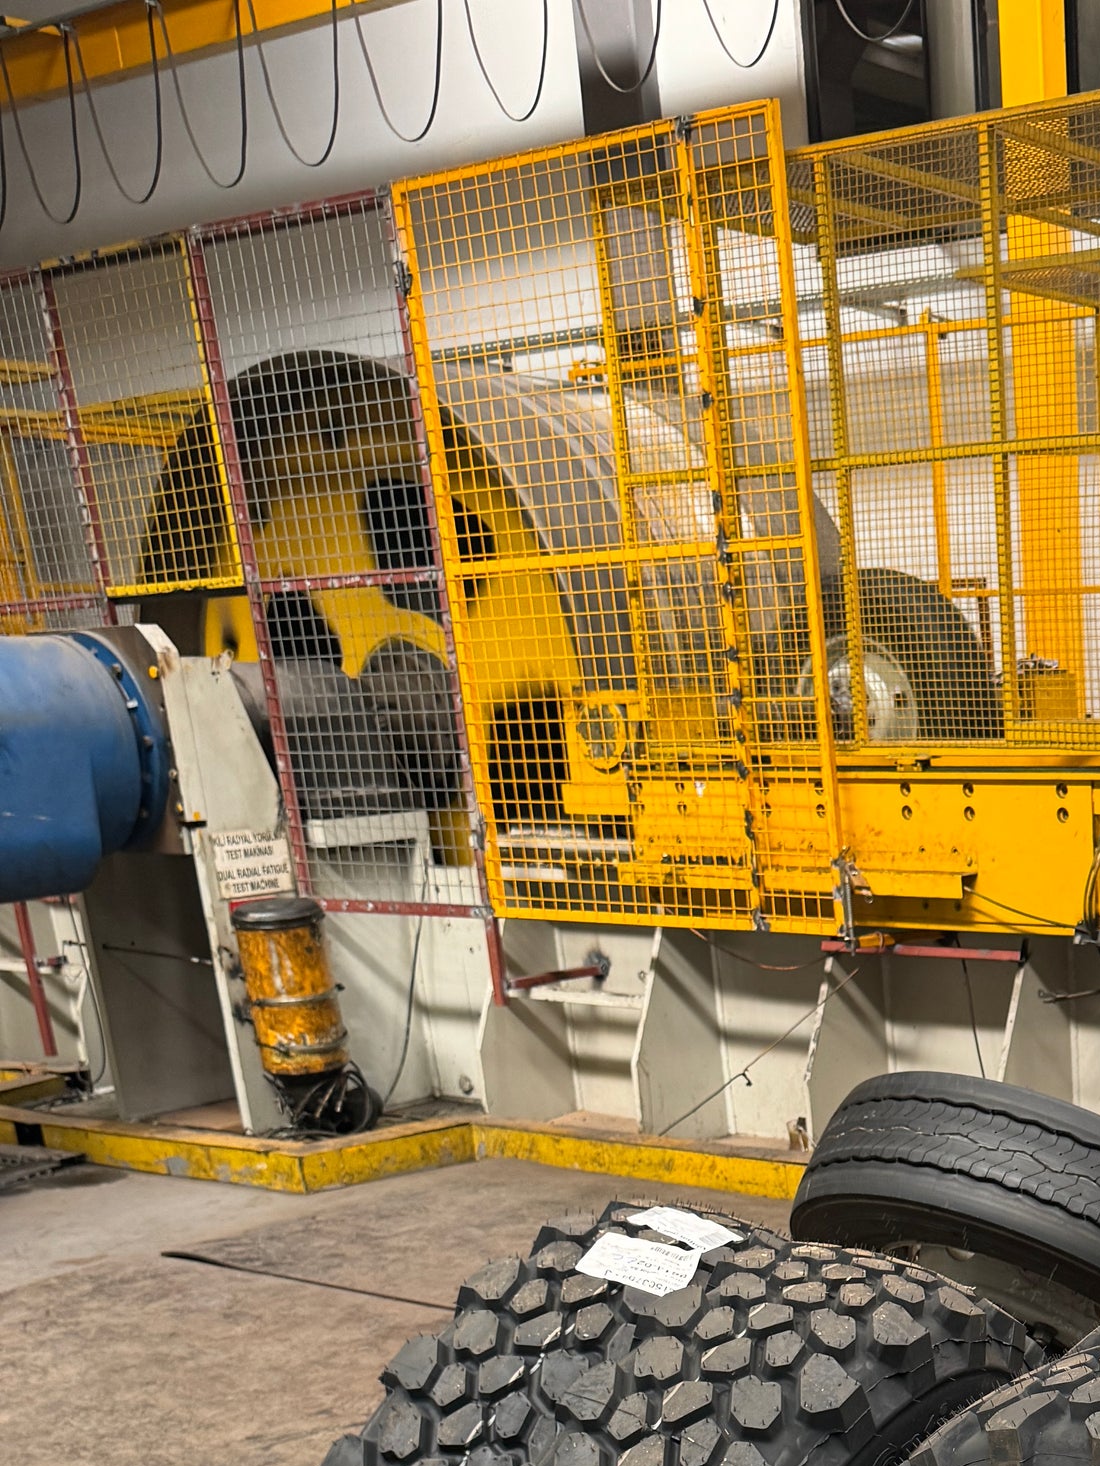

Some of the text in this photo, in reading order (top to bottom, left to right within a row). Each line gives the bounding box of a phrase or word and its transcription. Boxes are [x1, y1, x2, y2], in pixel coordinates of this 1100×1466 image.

[225, 848, 242, 860] TEST
[216, 862, 289, 881] DUAL RADIAL FATIGUE
[232, 878, 280, 894] TEST MACHINE
